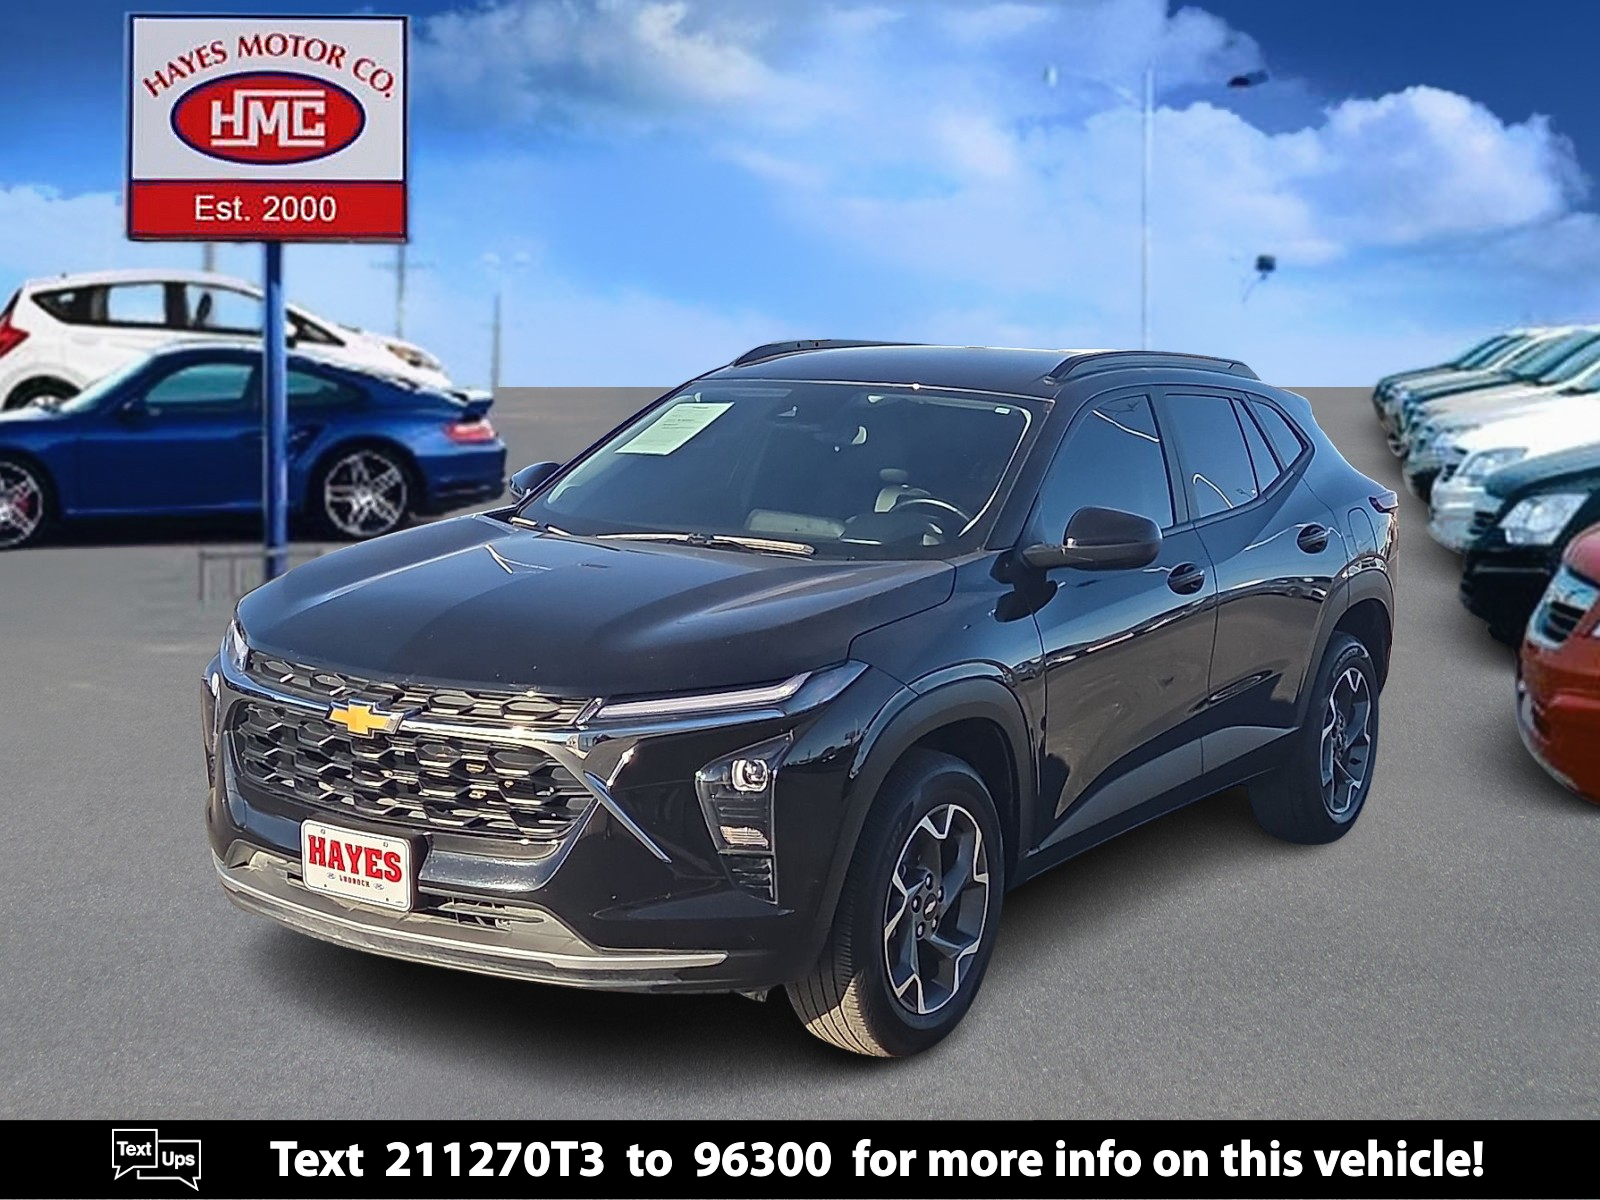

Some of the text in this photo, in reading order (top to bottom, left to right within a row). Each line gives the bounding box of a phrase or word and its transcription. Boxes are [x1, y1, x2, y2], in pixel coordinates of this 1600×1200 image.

[142, 33, 395, 98] HAYES MOTOR CO.
[210, 89, 326, 147] HMC
[194, 195, 337, 222] Est. 2000
[307, 834, 402, 882] HAYES
